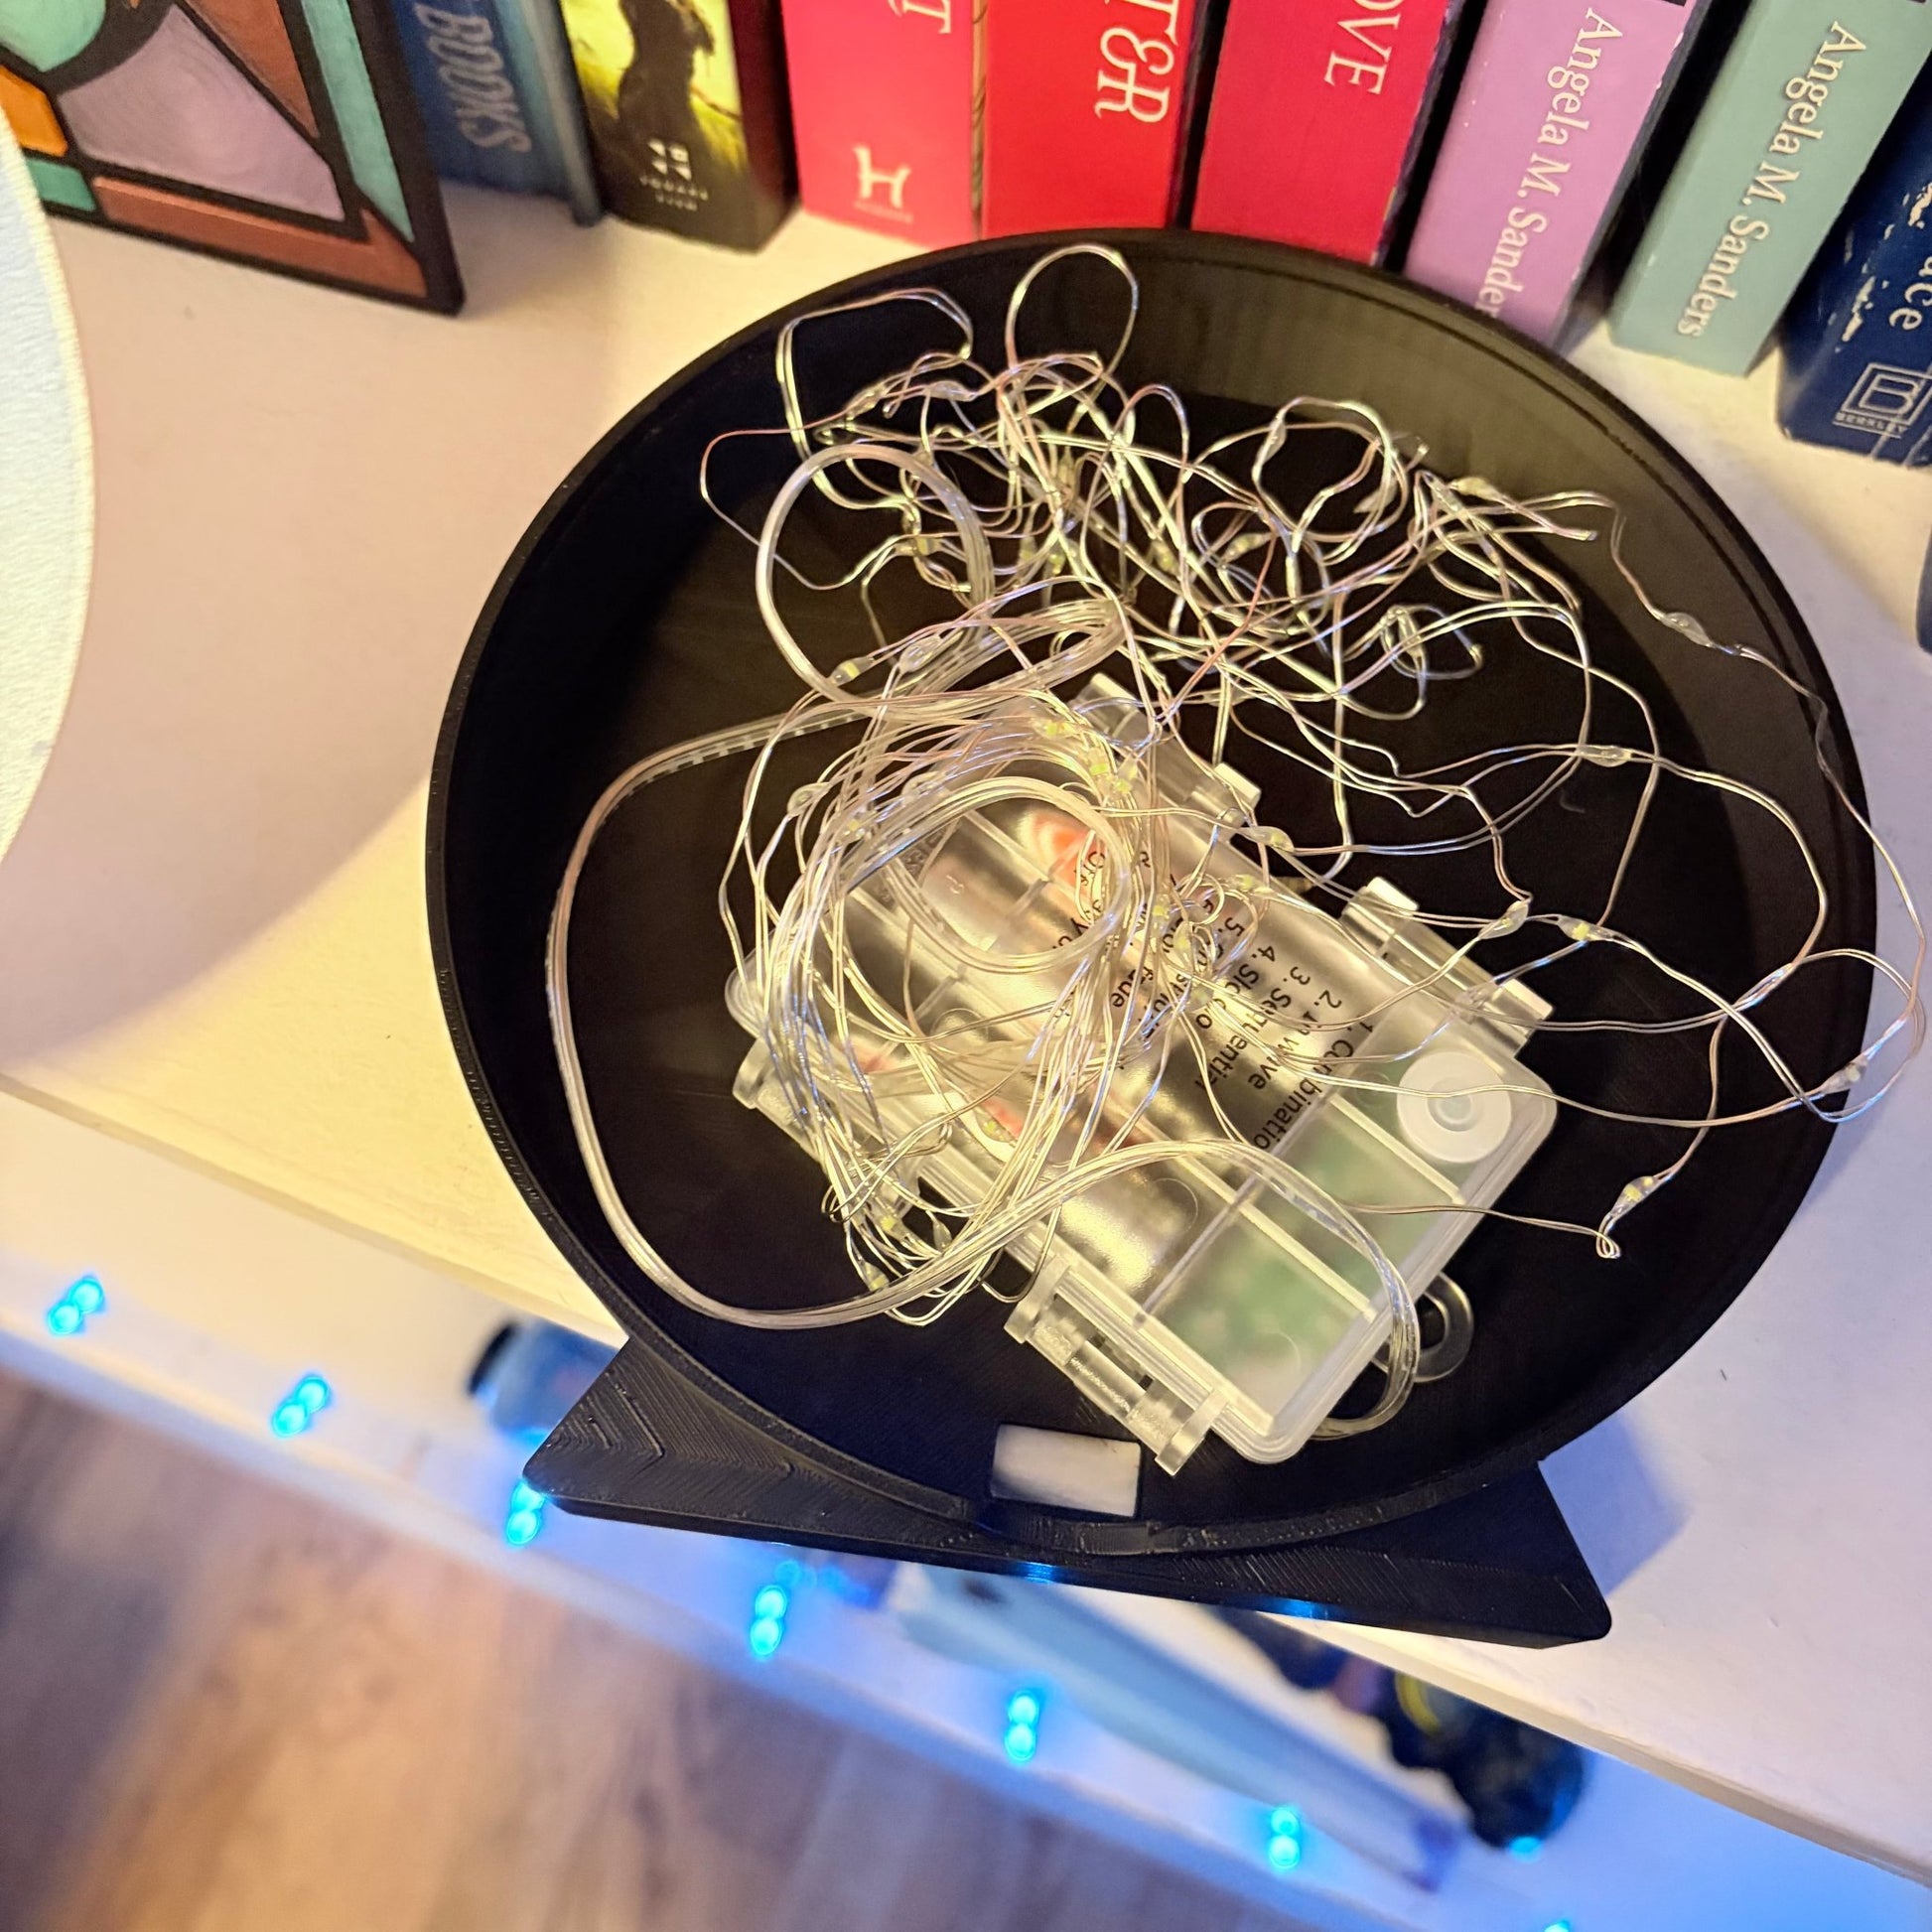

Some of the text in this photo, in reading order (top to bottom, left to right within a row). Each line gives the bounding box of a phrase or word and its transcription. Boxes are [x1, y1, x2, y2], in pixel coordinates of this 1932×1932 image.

[1323, 0, 1402, 95] VE
[414, 2, 532, 153] BOOKS
[1474, 7, 1623, 318] Angela M. Sander
[1677, 20, 1867, 338] Angela M. Sanders
[1216, 916, 1246, 937] 5.
[1251, 945, 1276, 962] 4.
[1283, 965, 1311, 986] 3.
[1312, 989, 1343, 1010] 2.
